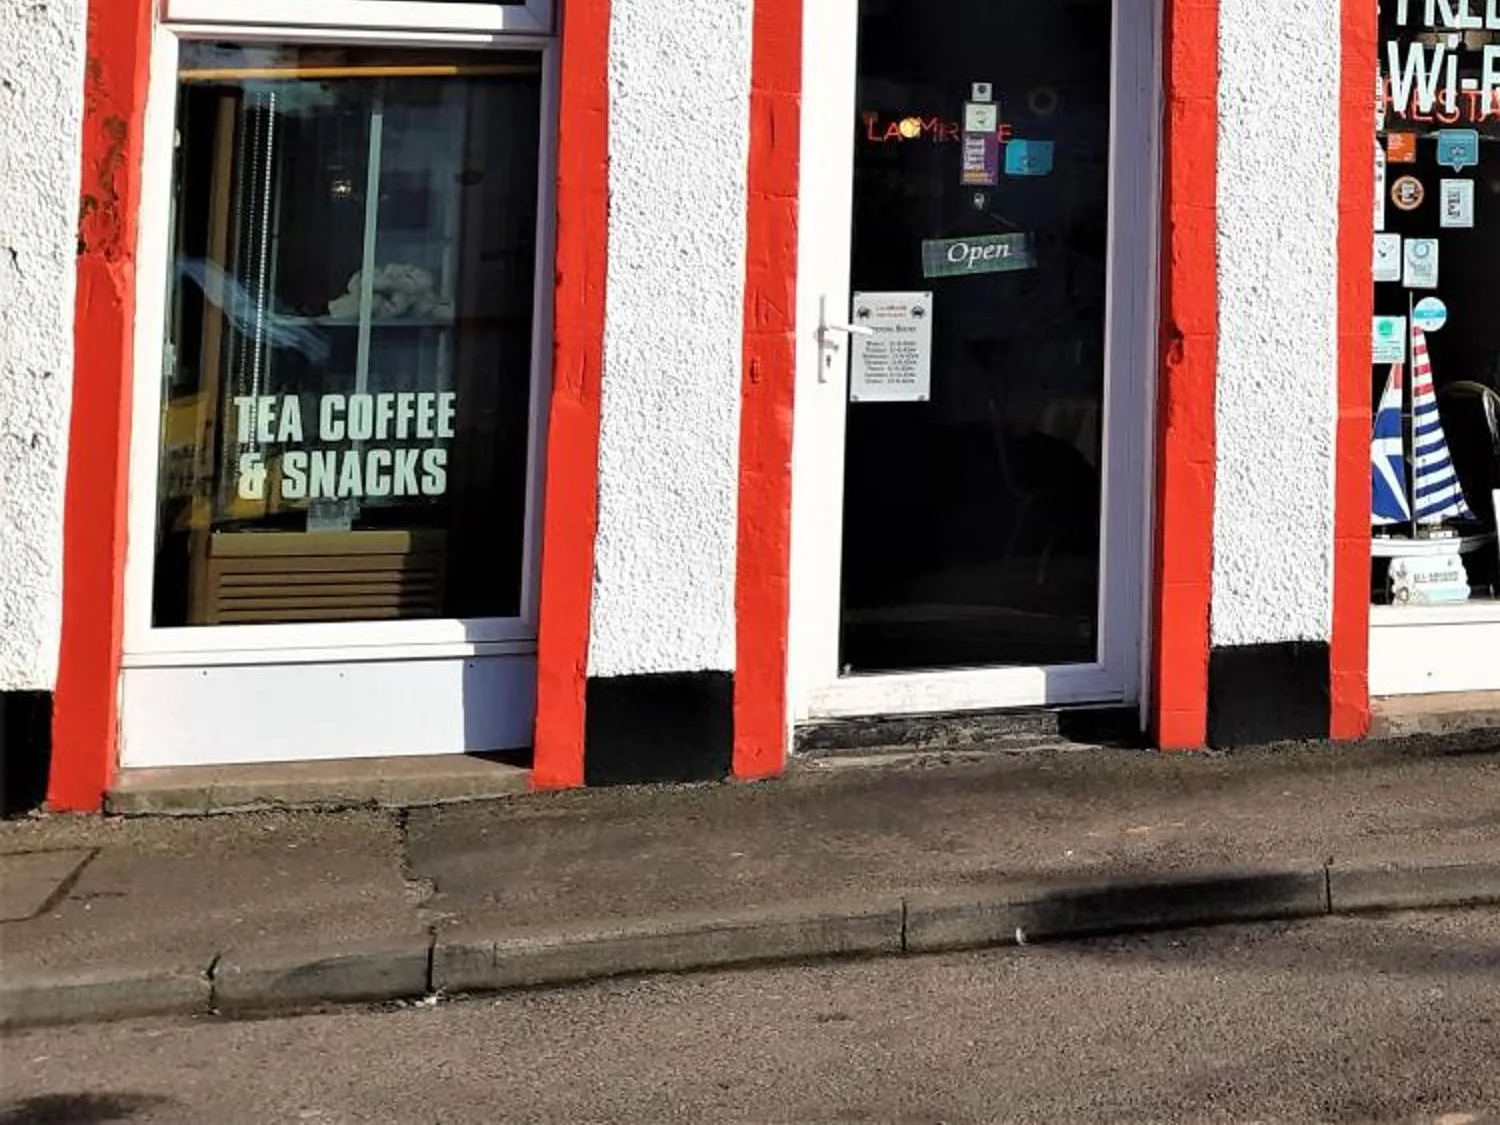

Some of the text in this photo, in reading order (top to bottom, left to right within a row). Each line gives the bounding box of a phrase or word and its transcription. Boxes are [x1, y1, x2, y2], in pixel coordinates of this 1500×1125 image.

[947, 241, 1012, 269] Open
[234, 392, 456, 443] TEA COFFEE
[237, 448, 448, 500] & SNACKS
